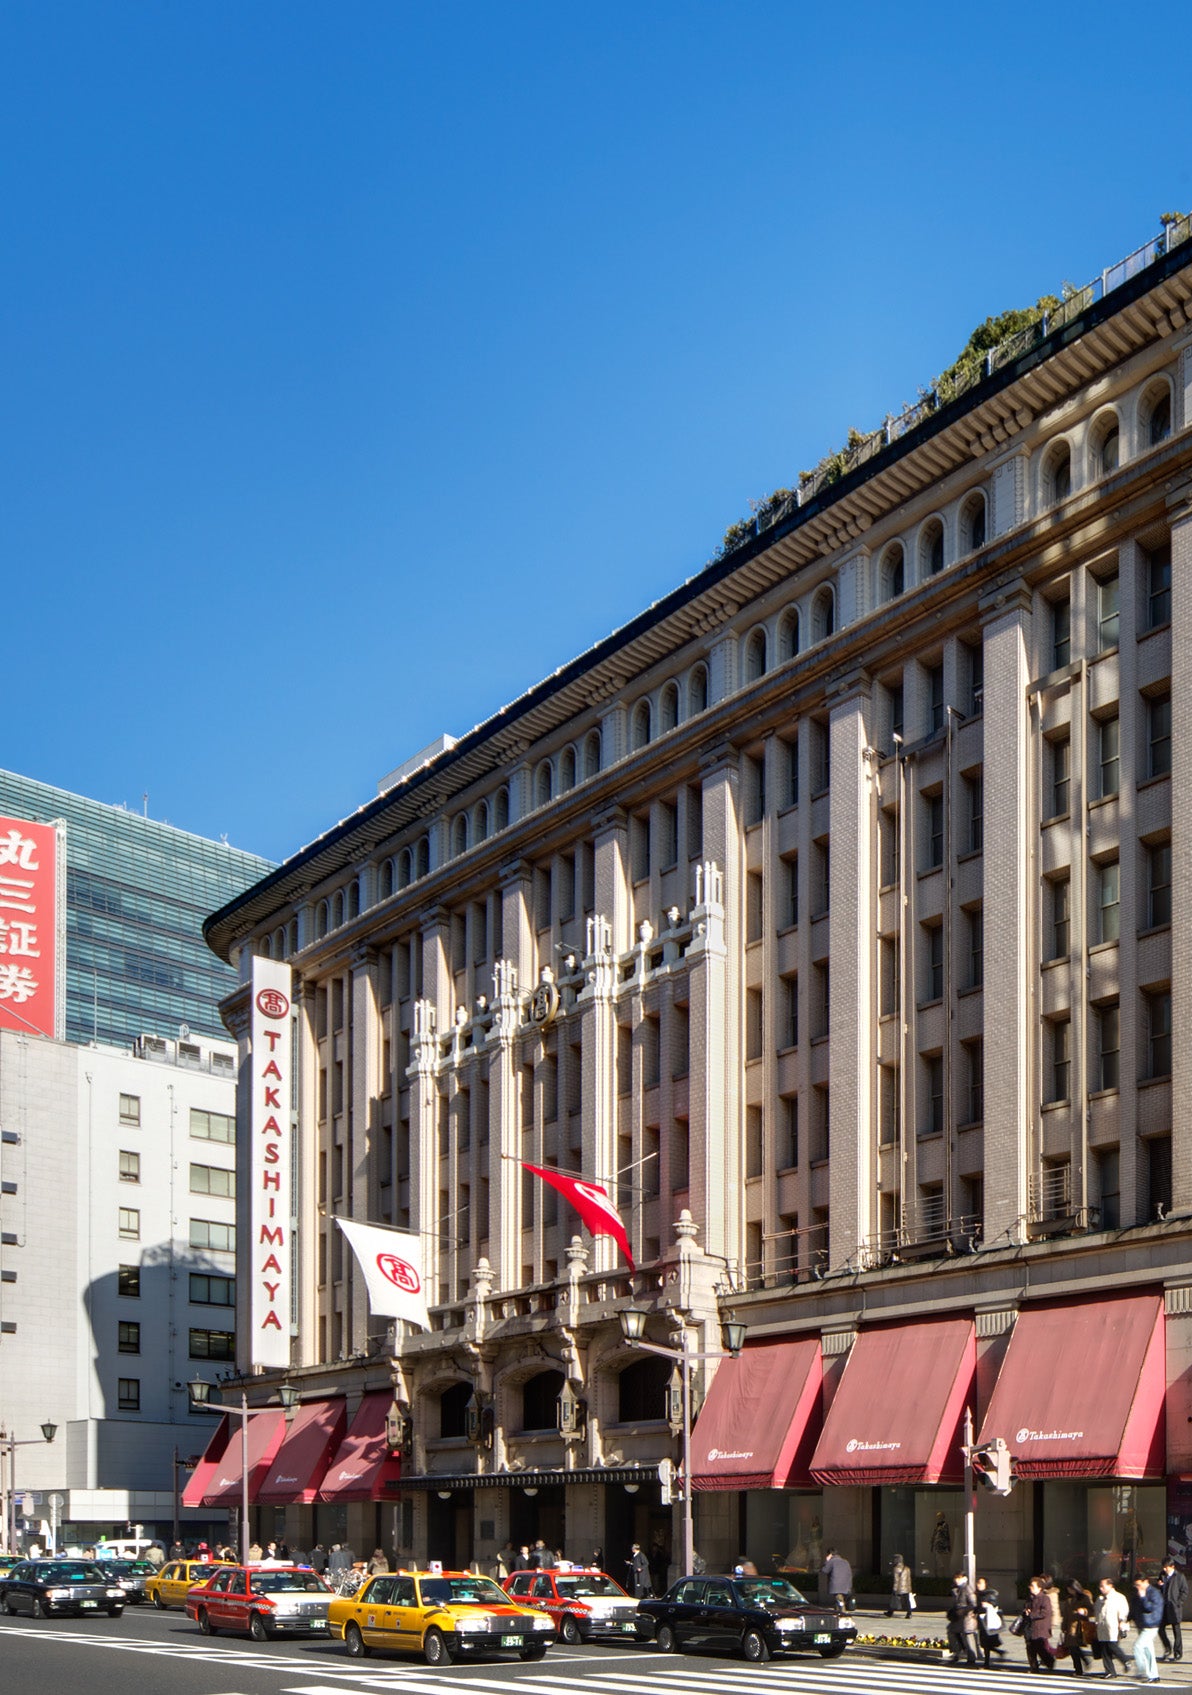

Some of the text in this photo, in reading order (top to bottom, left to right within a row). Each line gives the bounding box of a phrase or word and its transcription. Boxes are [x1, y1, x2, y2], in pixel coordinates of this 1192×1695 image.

[0, 829, 41, 1004] 丸三証券
[259, 1029, 284, 1331] TAKASHIMAYA
[1029, 1430, 1083, 1441] Takashimaya
